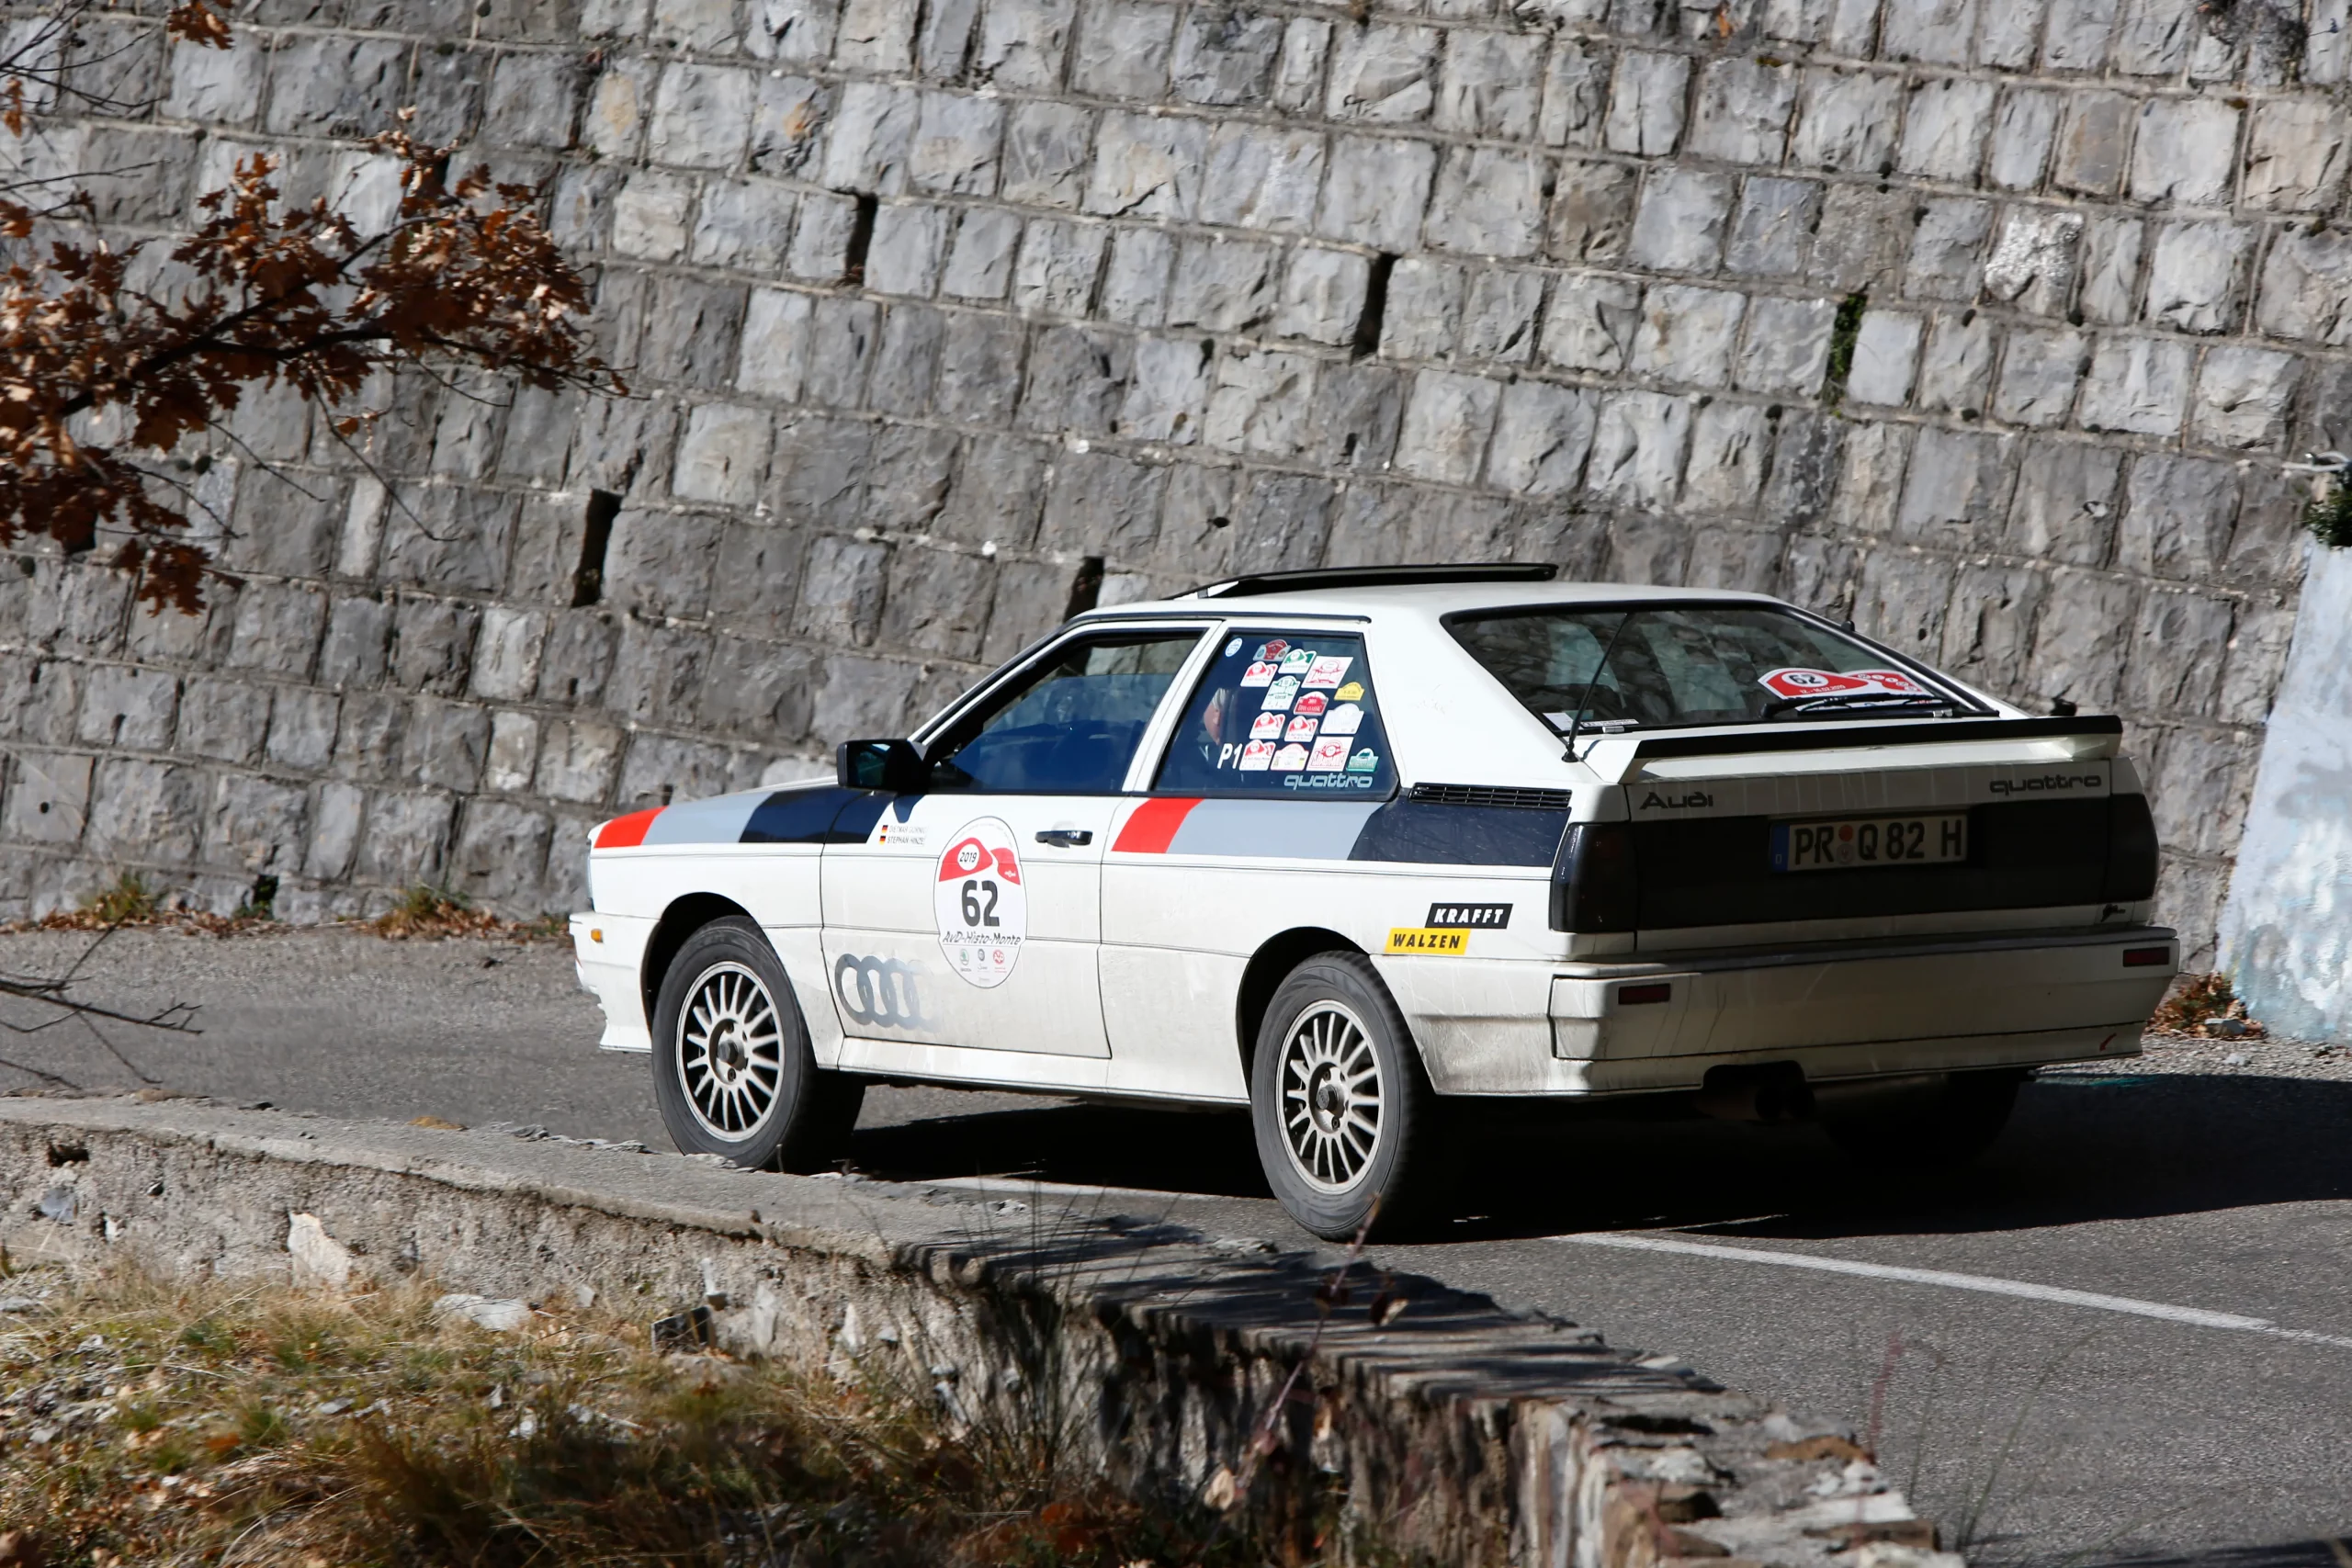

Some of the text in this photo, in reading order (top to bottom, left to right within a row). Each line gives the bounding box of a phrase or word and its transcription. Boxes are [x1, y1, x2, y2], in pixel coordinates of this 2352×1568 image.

[1788, 674, 1823, 685] 62
[1283, 773, 1374, 791] quattro
[1989, 773, 2102, 796] quattro
[1639, 791, 1714, 810] Audi
[1775, 818, 1962, 865] D PR Q 82 H
[959, 852, 978, 863] 2019
[961, 879, 1001, 928] 62
[1433, 908, 1504, 924] KRAFFT
[942, 931, 1022, 945] AvD-Histo-Monte
[1393, 933, 1461, 949] WALZEN
